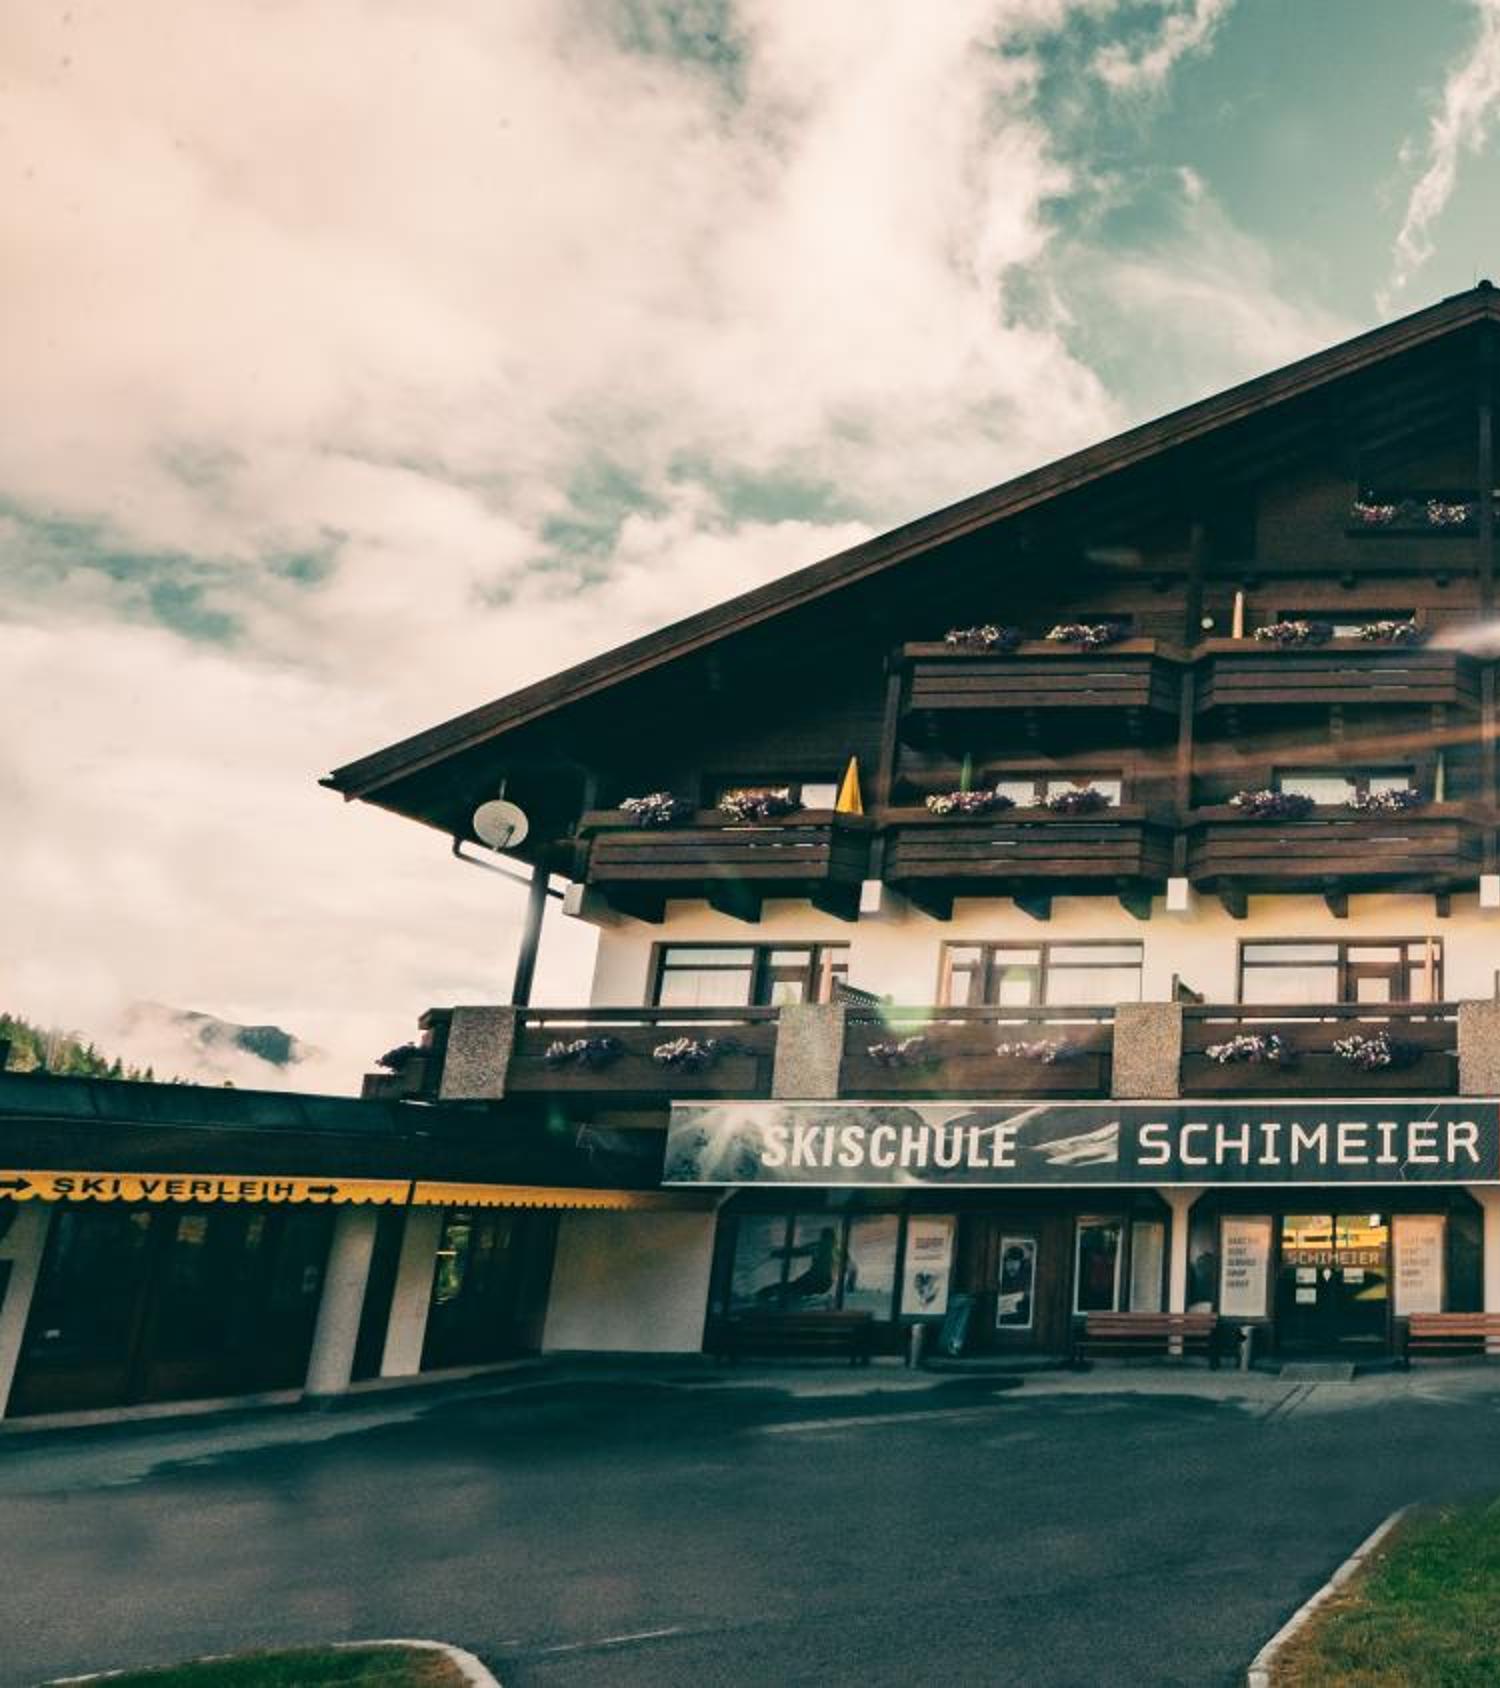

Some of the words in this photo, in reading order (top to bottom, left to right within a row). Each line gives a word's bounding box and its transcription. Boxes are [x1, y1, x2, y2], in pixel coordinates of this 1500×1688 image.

[761, 1125, 1019, 1168] SKISCHULE
[1138, 1121, 1481, 1166] SCHIMEIER
[52, 1177, 120, 1194] SKI
[140, 1179, 295, 1196] VERLEIH
[1287, 1250, 1380, 1265] SCHIMEIER
